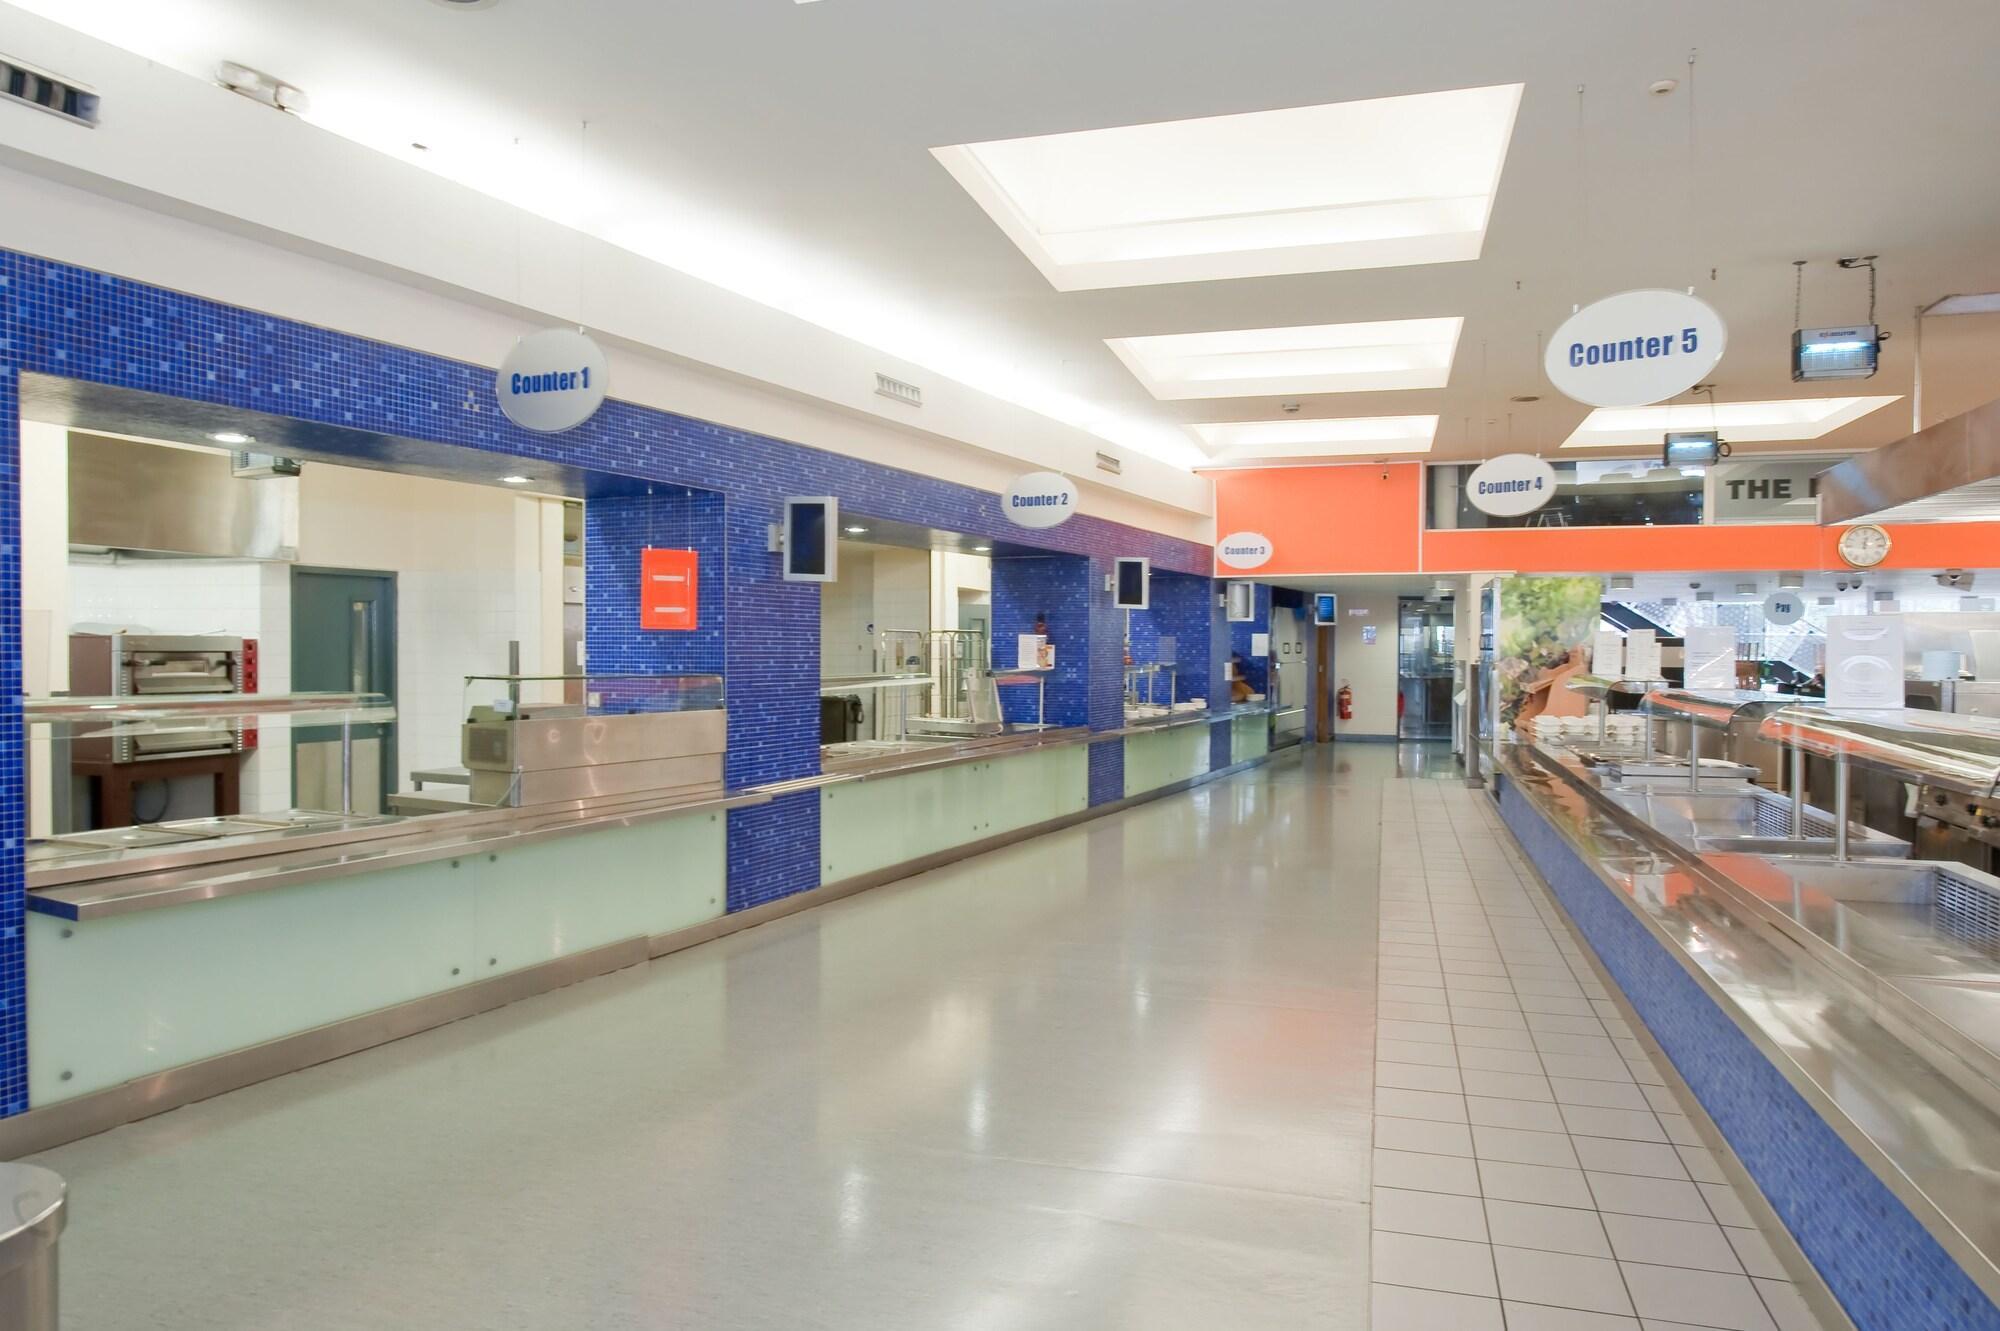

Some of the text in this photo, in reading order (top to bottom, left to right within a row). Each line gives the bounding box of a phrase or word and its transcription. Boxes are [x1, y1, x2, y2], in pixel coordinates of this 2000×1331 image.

[1569, 327, 1698, 367] Counter 5
[511, 366, 590, 395] Counter 1
[1478, 476, 1543, 495] Counter 4
[1725, 479, 1792, 500] THE
[1012, 492, 1069, 507] Counter 2
[1224, 546, 1265, 555] Counter 3
[1775, 602, 1791, 613] Pay
